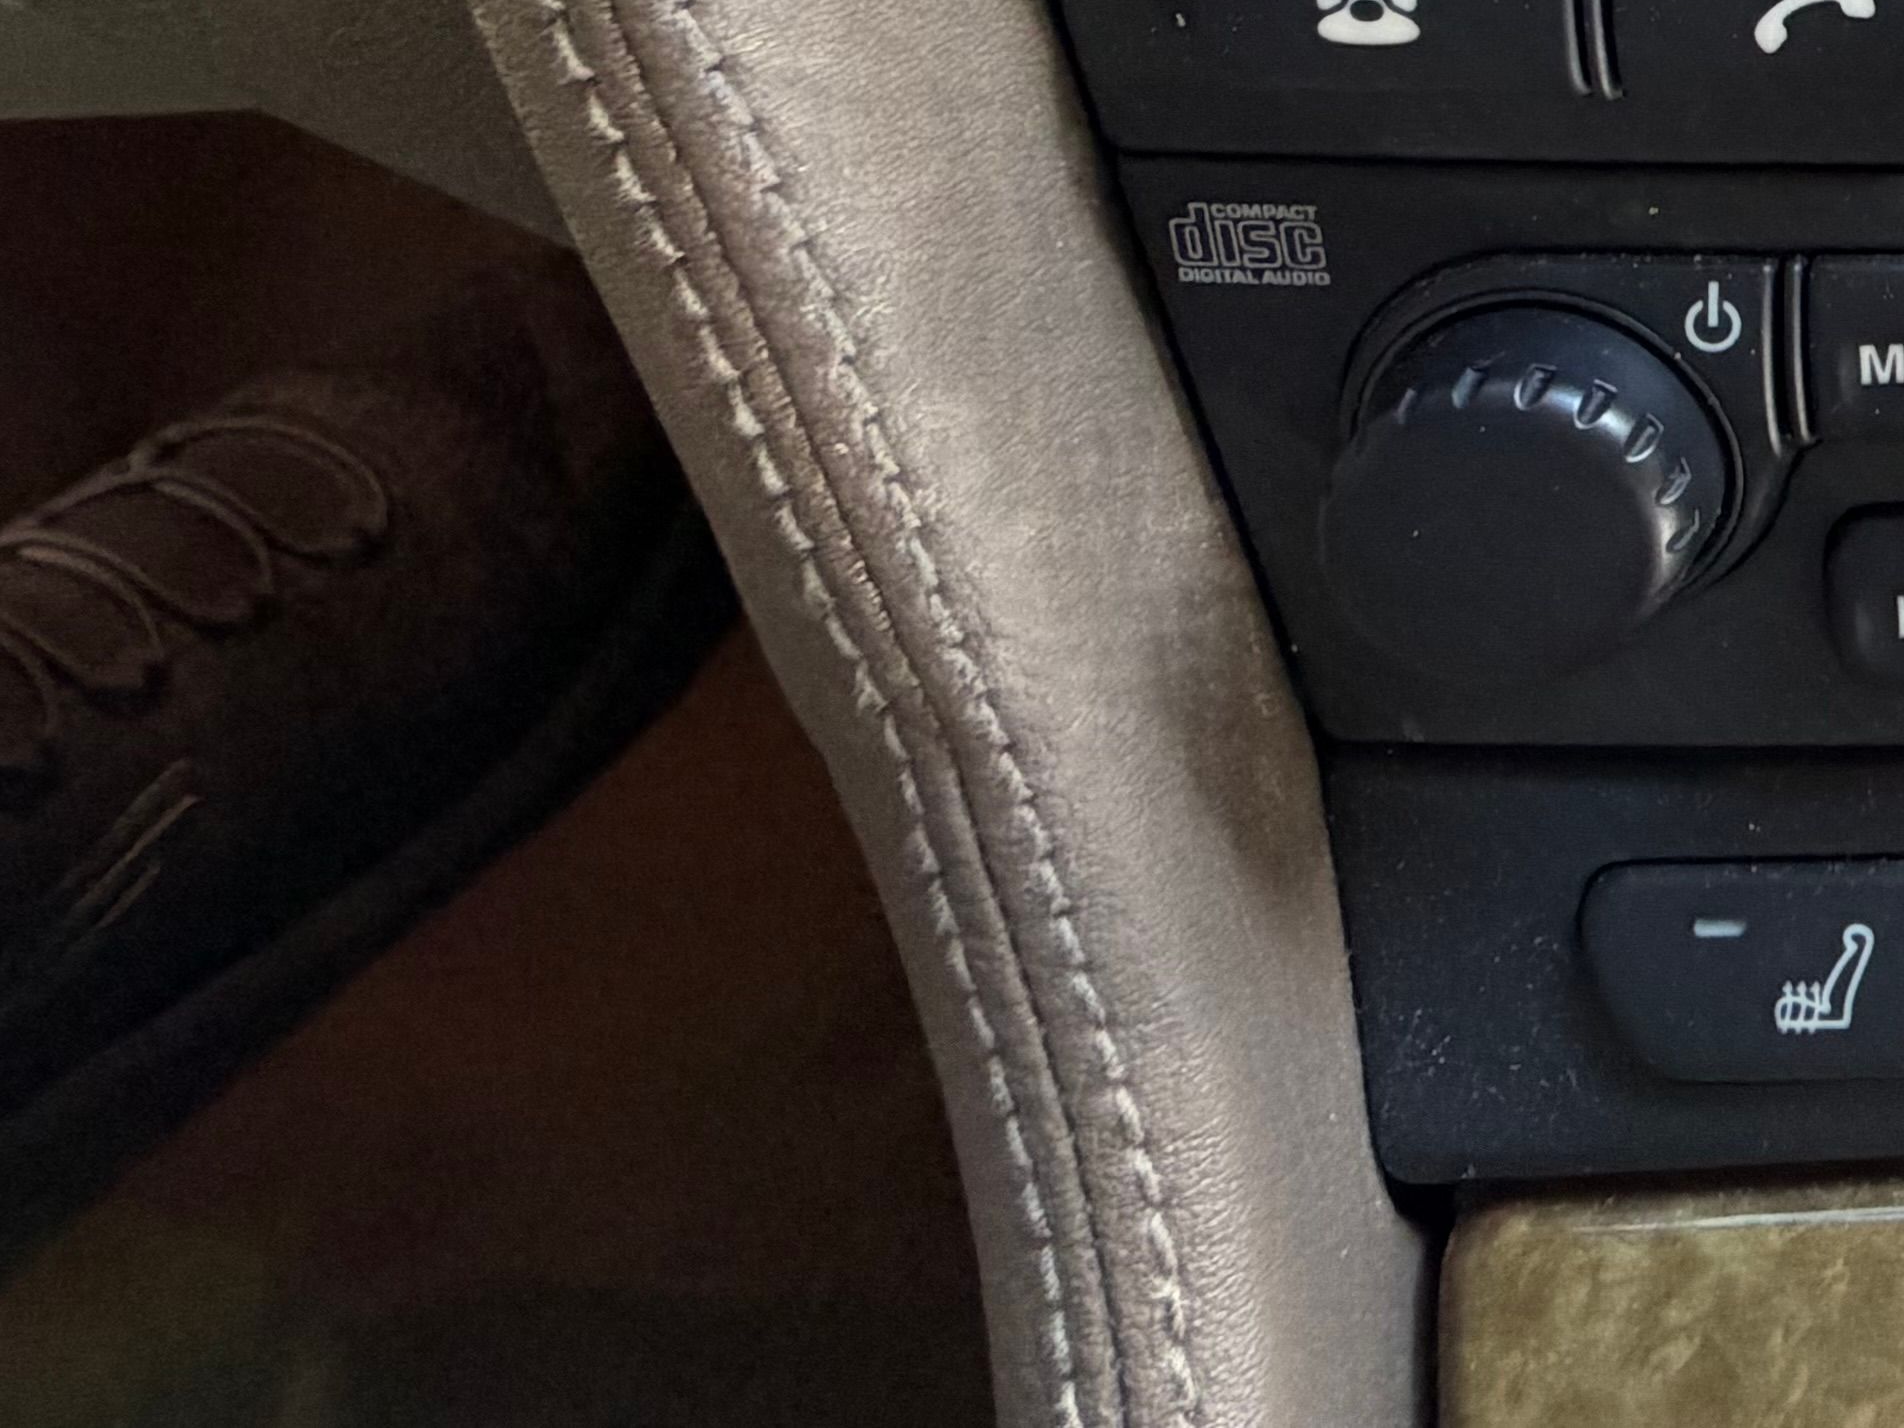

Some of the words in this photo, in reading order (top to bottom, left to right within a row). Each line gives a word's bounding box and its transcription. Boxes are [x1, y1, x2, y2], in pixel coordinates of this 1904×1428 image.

[1209, 202, 1319, 221] COMPACT
[1177, 266, 1260, 285] DIGITAL
[1261, 269, 1332, 286] AUDIO
